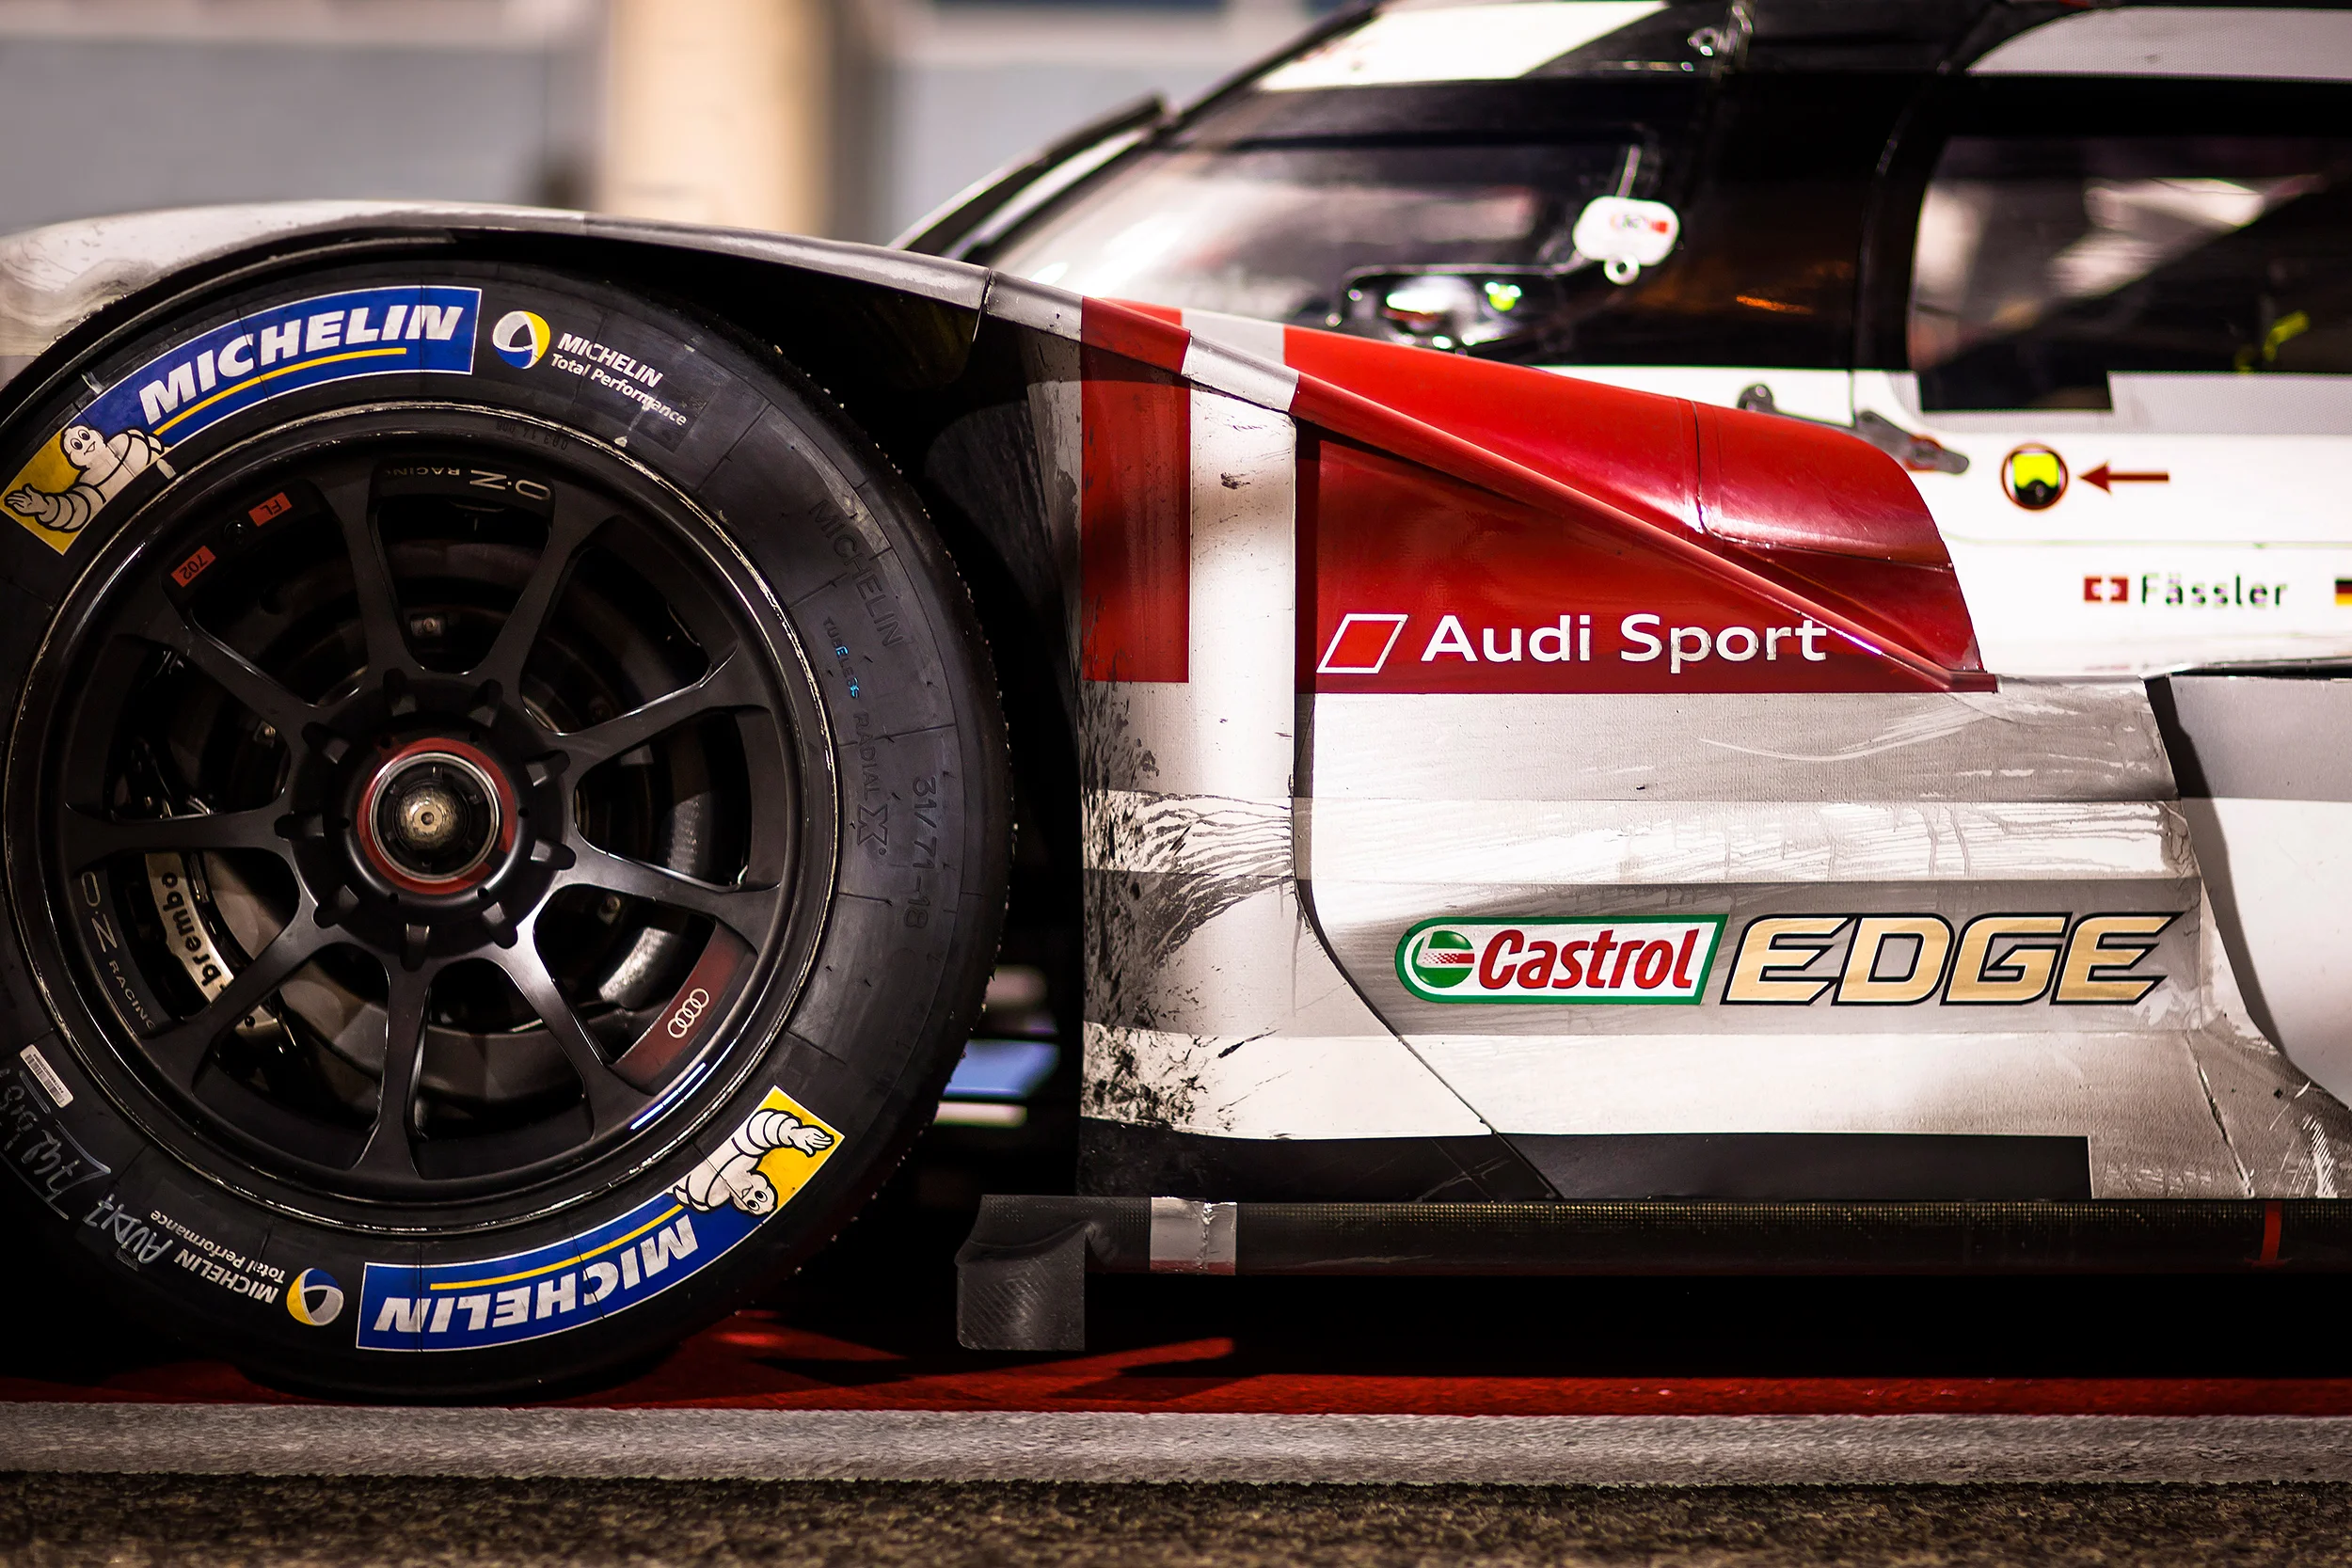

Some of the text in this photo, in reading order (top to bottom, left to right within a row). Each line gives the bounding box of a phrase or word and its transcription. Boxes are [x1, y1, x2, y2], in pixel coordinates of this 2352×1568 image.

[139, 303, 464, 426] MICHELIN
[551, 352, 688, 427] Total Performance
[557, 332, 664, 387] MICHELIN
[260, 499, 282, 515] FL
[179, 555, 208, 580] 702
[807, 498, 906, 649] MICHELIN
[2140, 573, 2289, 607] Fässler
[1421, 612, 1828, 674] Audi Sport
[851, 712, 882, 800] RADIAL
[162, 871, 222, 987] brembo
[1477, 912, 2185, 1006] Castrol EDGE
[149, 1209, 287, 1285] Total Performance
[173, 1249, 279, 1306] MICHELIN
[373, 1212, 699, 1333] MICHELIN
